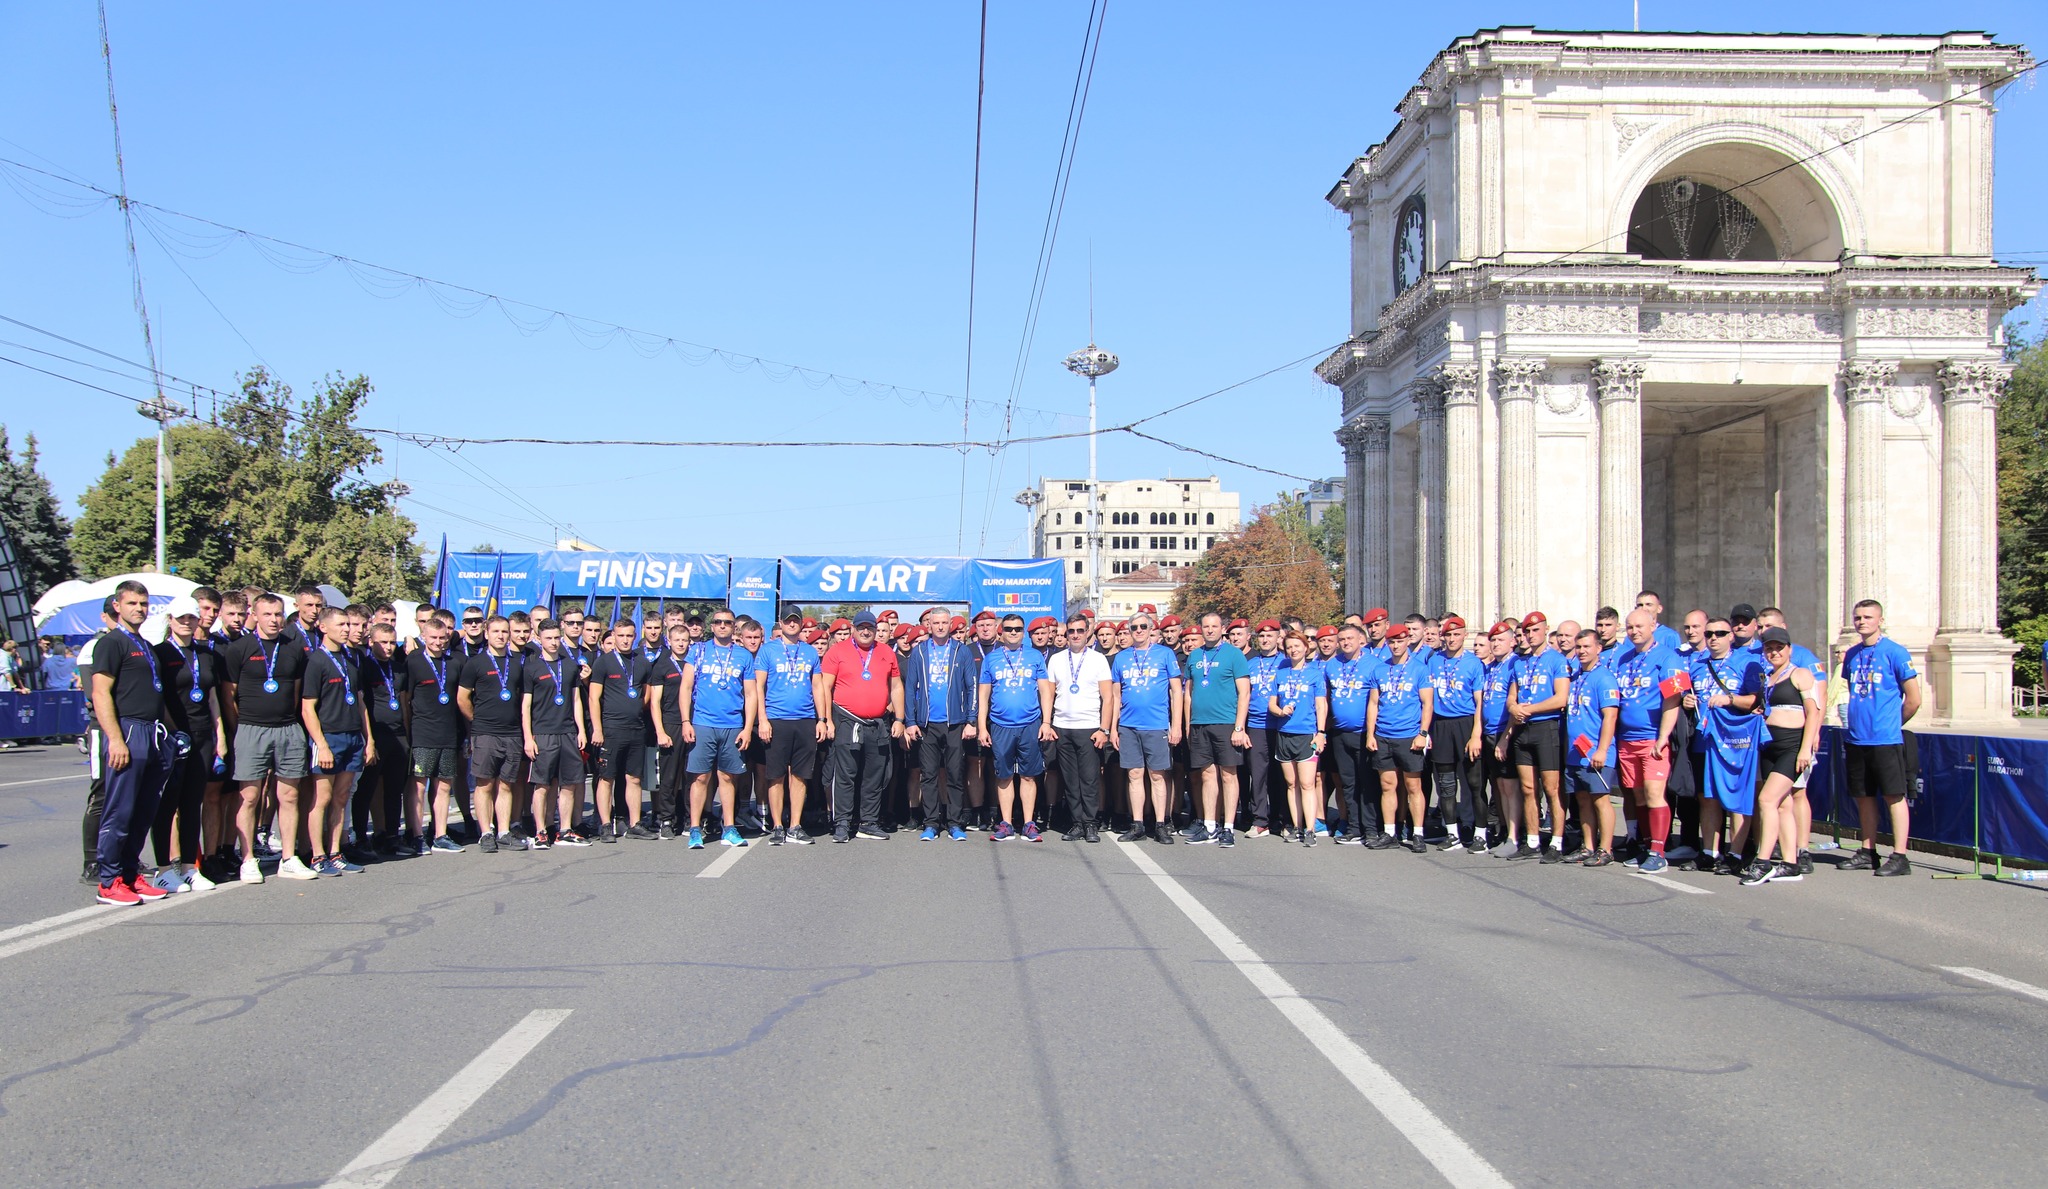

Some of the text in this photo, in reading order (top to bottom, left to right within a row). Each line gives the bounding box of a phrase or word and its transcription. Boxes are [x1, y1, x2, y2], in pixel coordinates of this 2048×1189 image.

[458, 571, 527, 580] EURO MAATHON
[577, 560, 693, 589] FINISH
[819, 564, 937, 593] START
[982, 578, 1052, 586] EURO MARATHON
[1987, 756, 2005, 767] EURO
[1987, 765, 2024, 777] MARATHON
